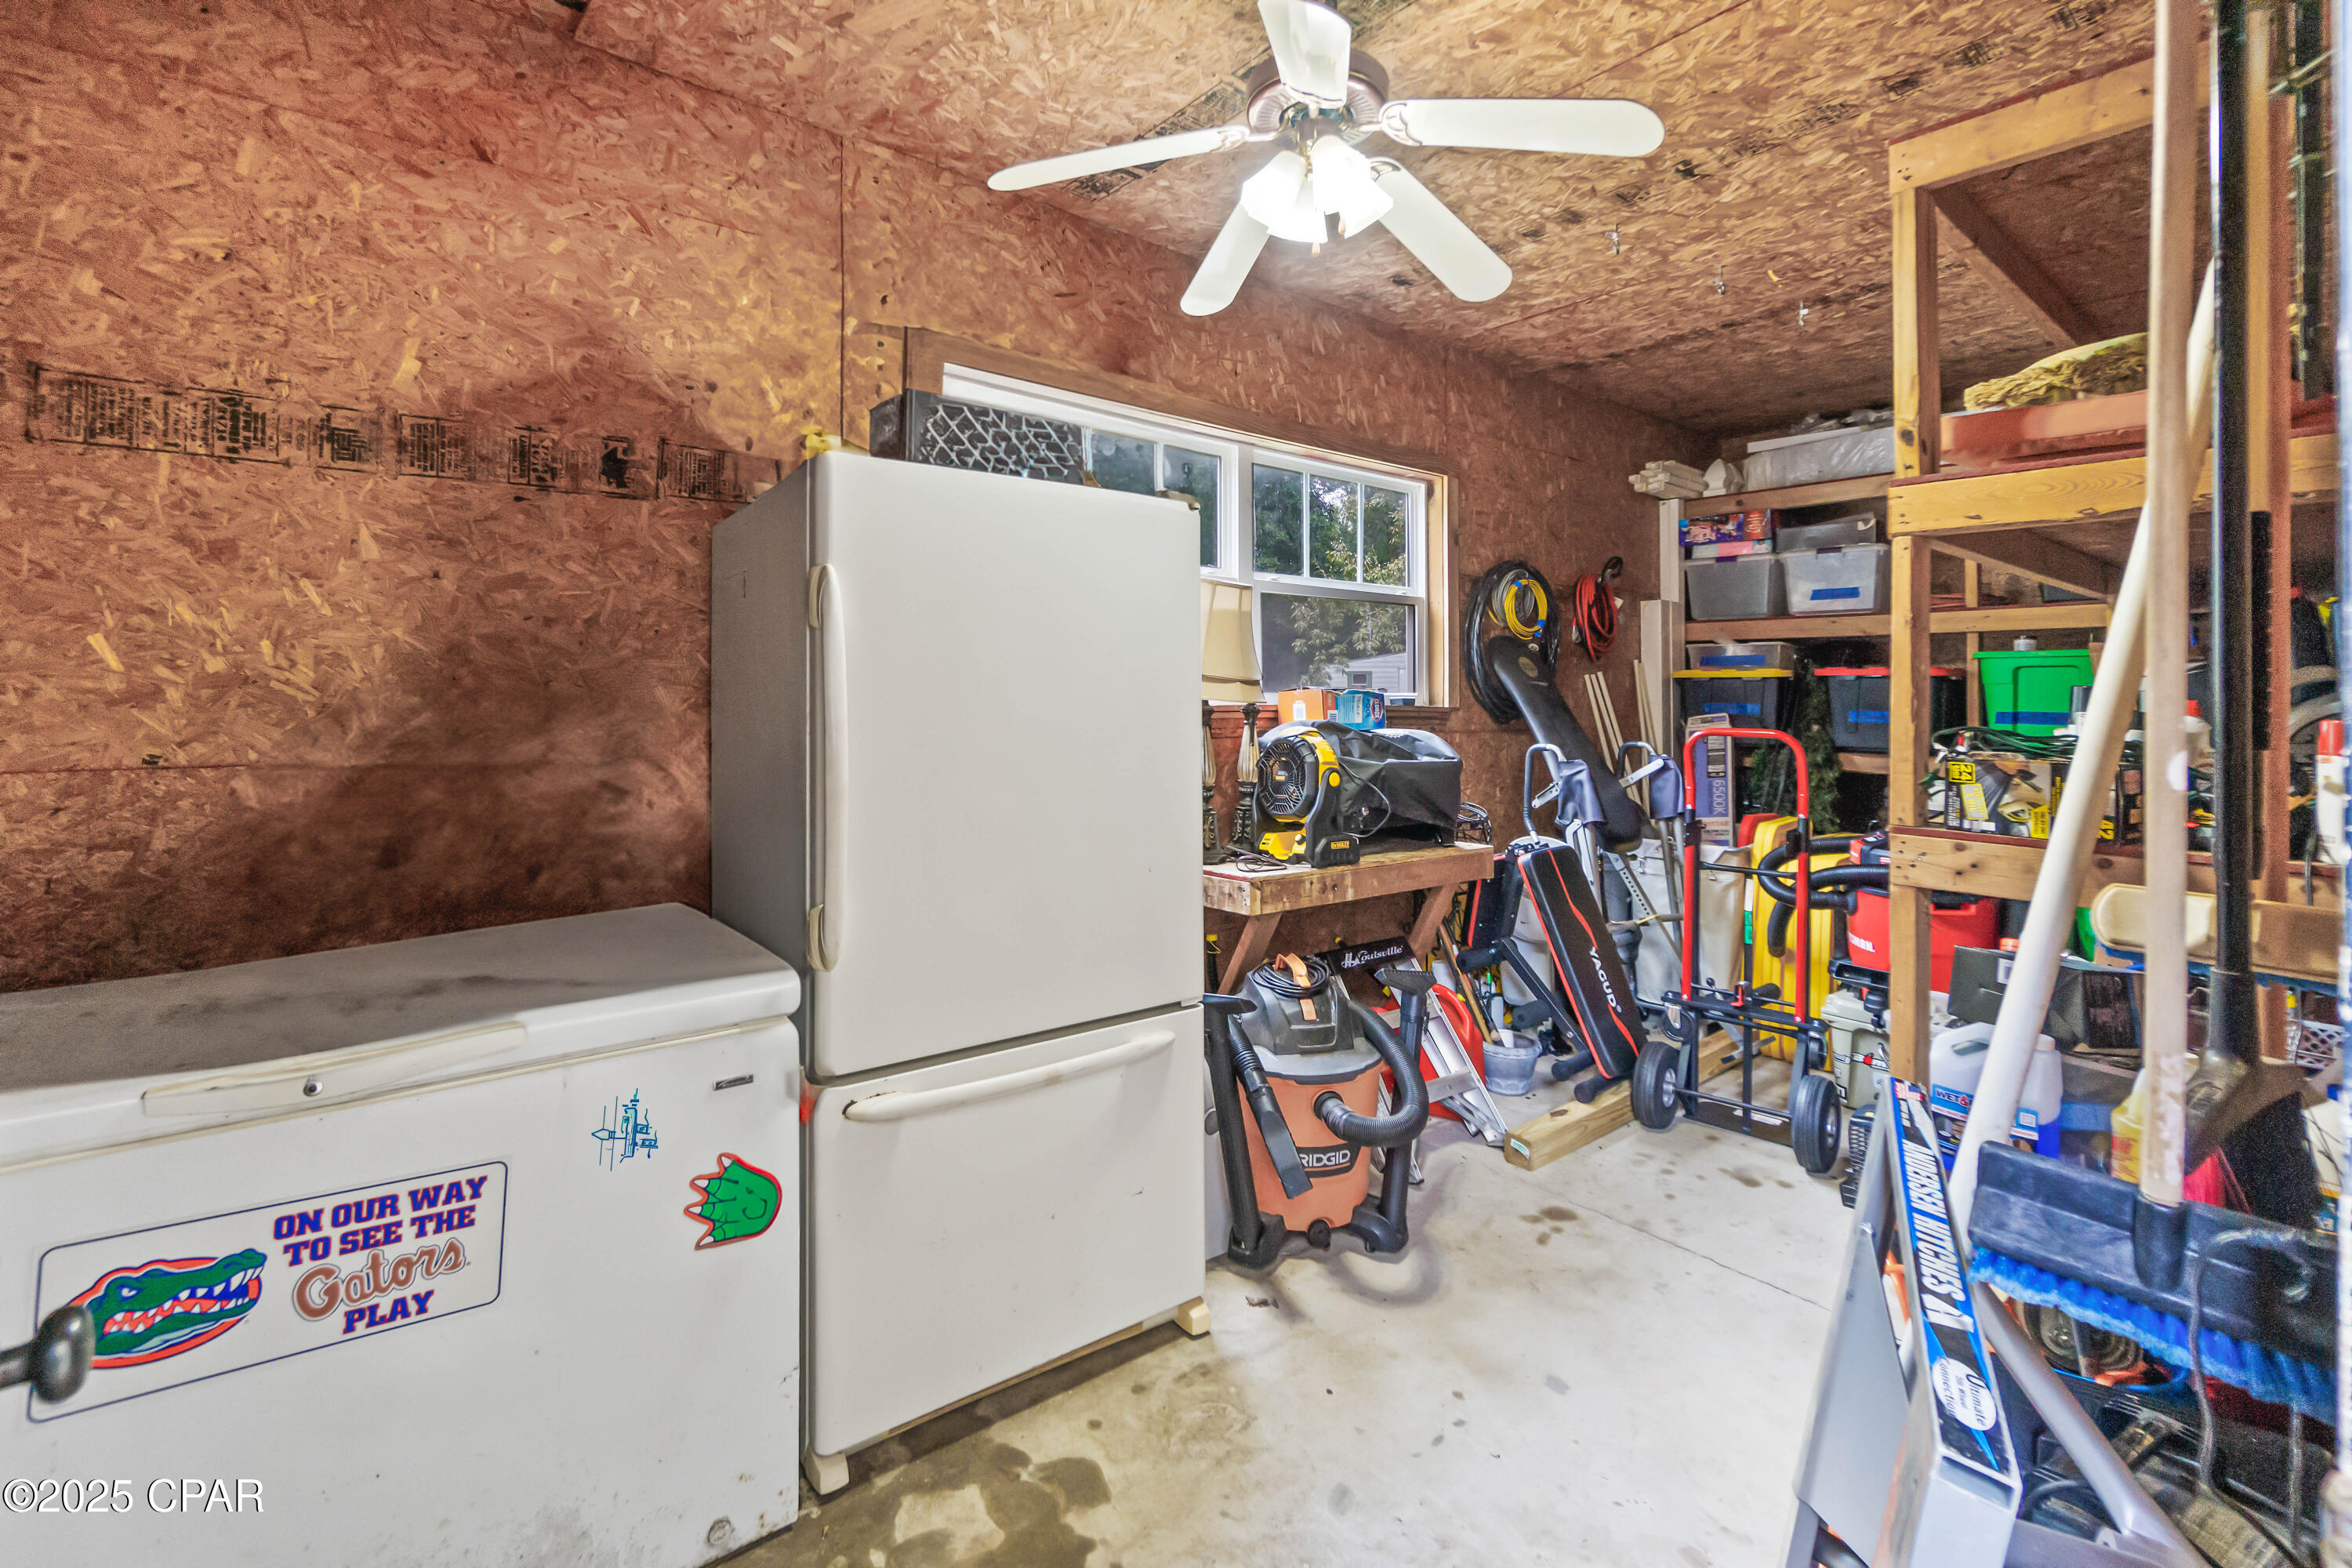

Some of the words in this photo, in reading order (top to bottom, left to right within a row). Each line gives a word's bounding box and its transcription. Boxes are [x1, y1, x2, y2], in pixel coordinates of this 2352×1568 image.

[1712, 779, 1726, 815] 6500K
[1356, 946, 1403, 964] Louisville
[1298, 1149, 1351, 1167] RIDGID
[1901, 1138, 1948, 1220] ANDERSEN
[274, 1208, 325, 1240] ON
[330, 1194, 401, 1229] OUR
[408, 1175, 488, 1212] WAY
[283, 1236, 332, 1268] TO
[339, 1220, 404, 1256] SEE
[410, 1204, 477, 1240] THE
[292, 1237, 466, 1322] Gators
[1911, 1212, 1966, 1302] HITCHES
[342, 1289, 435, 1335] PLAY
[1965, 1374, 1987, 1427] Ultimate
